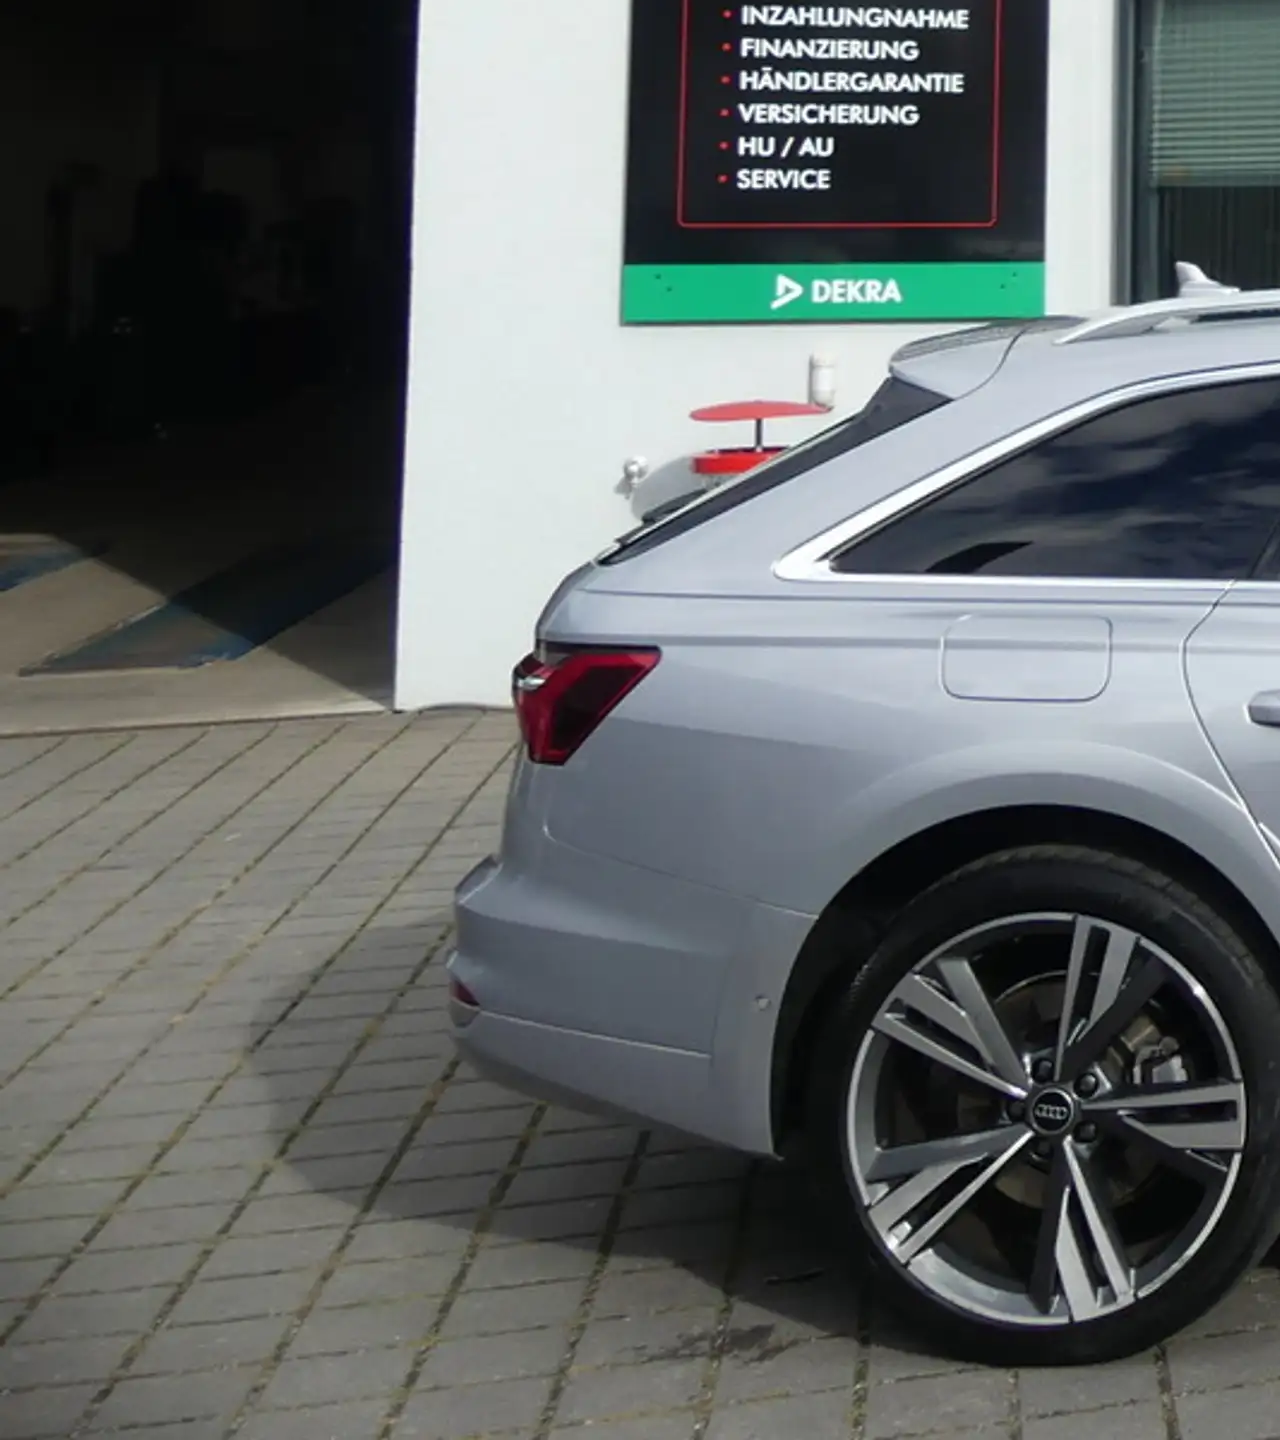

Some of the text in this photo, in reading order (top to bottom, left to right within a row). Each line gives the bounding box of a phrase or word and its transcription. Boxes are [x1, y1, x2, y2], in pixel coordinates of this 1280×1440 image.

[740, 4, 970, 30] INZAHLUNGNAHME
[739, 37, 920, 62] FINANZIERUNG
[738, 66, 965, 94] HÄNDLERGARANTIE
[737, 102, 920, 127] VERSICHERUNG
[737, 136, 835, 159] HU / AU
[736, 168, 831, 191] SERVICE
[810, 278, 902, 304] DEKRA
